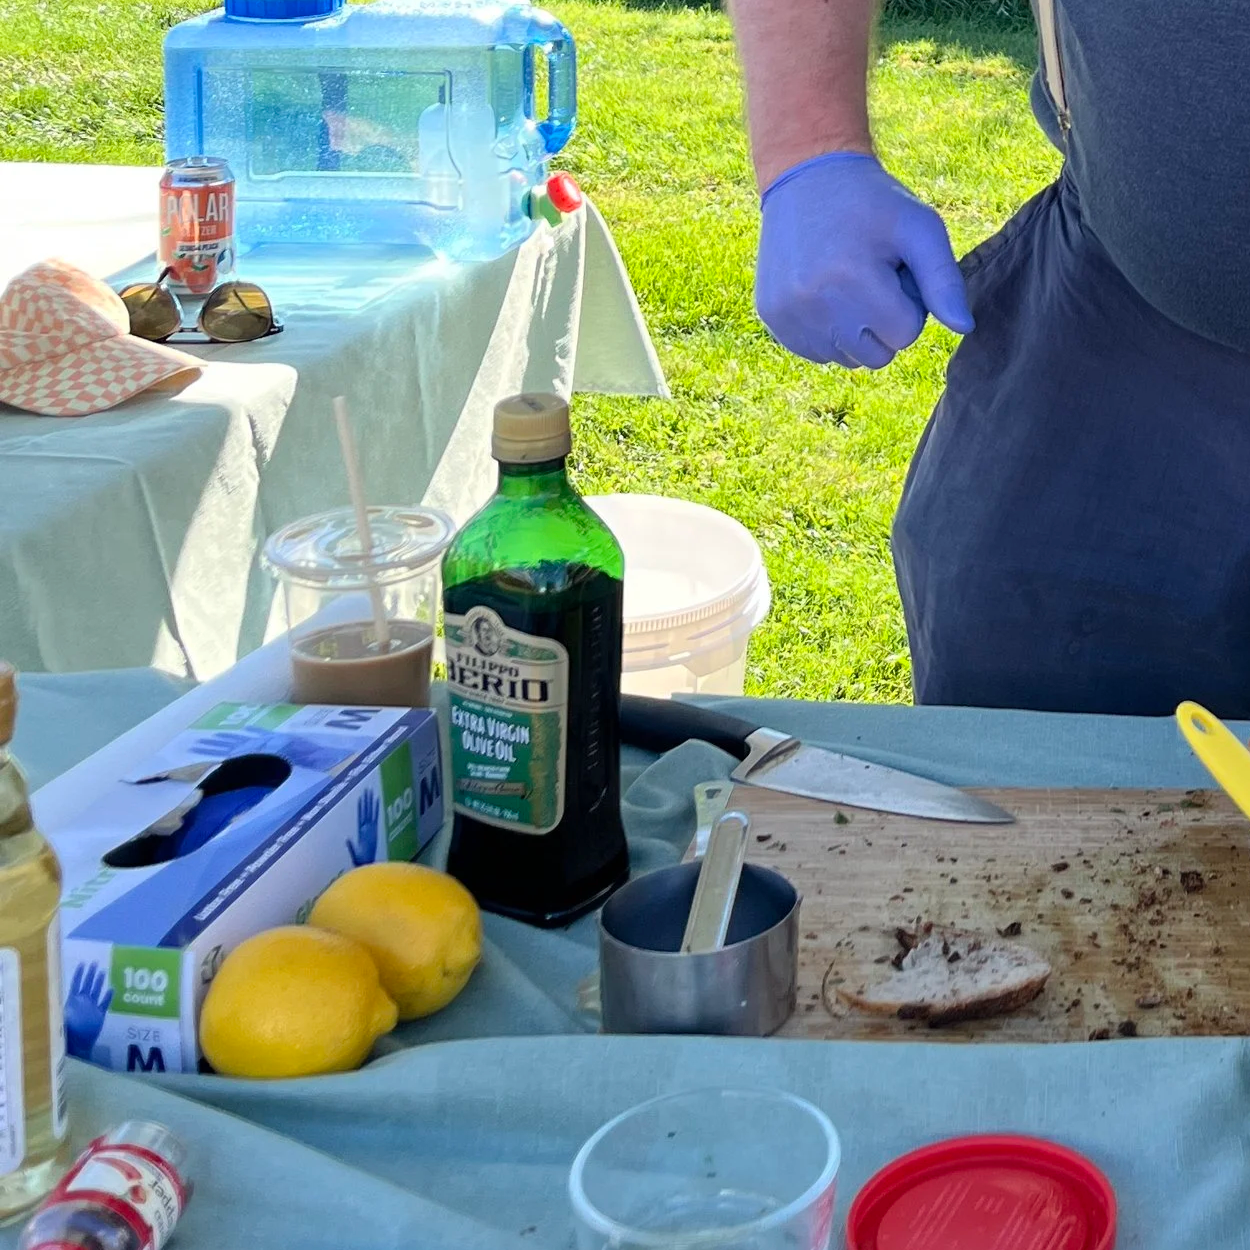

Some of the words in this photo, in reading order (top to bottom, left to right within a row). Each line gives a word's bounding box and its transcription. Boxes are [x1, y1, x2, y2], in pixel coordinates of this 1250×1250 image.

[166, 191, 229, 223] POLAR
[456, 653, 520, 678] FILIPPO
[451, 705, 487, 735] EXTRA
[485, 714, 530, 745] VIRGIN
[462, 729, 496, 759] OLIVE
[495, 739, 517, 764] OIL
[420, 765, 440, 816] M
[388, 786, 414, 826] 100
[123, 966, 169, 991] 100
[123, 991, 166, 1006] count
[127, 1027, 161, 1042] SIZE
[127, 1044, 166, 1072] M
